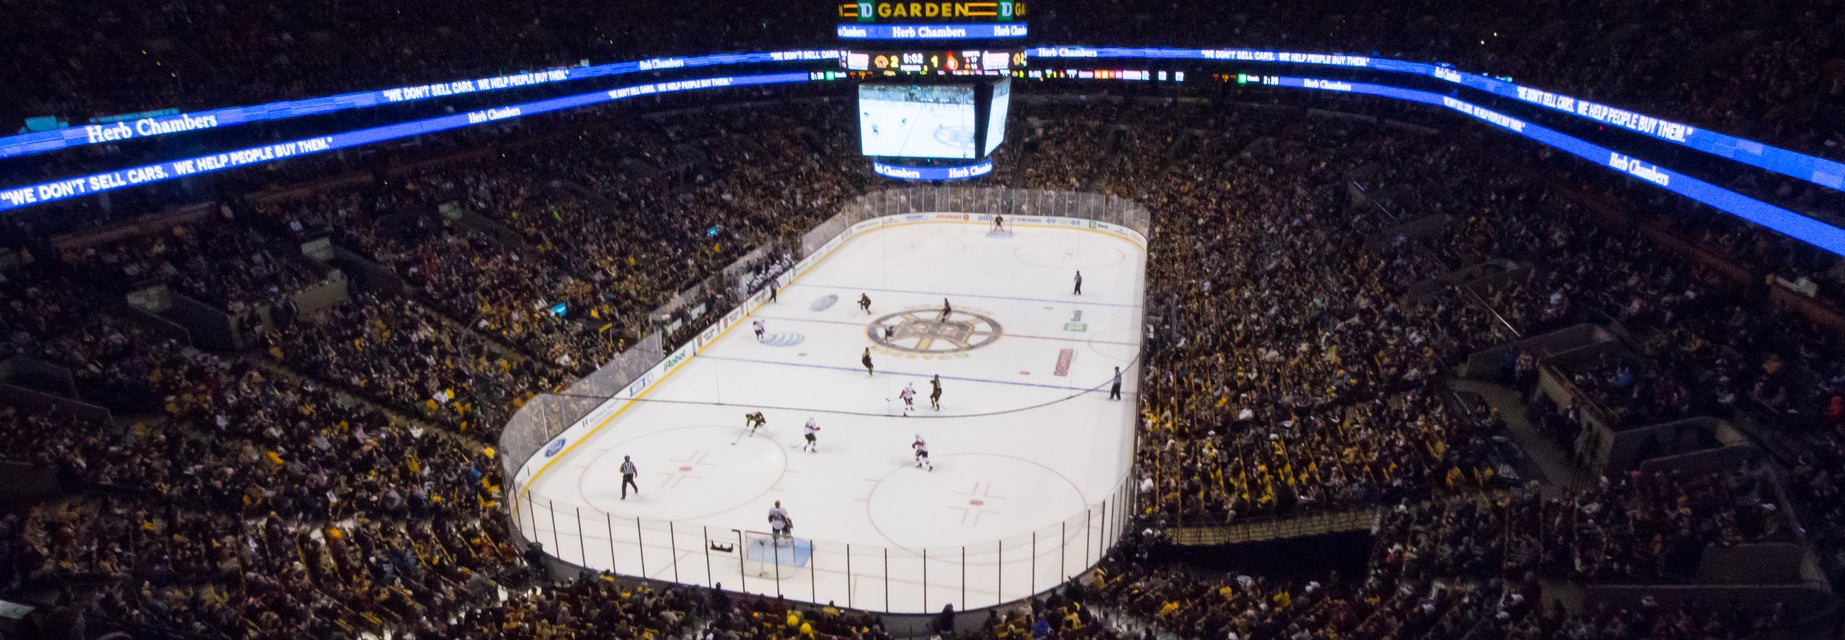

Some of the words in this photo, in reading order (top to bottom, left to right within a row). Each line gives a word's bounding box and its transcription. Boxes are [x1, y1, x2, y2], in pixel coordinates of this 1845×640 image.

[859, 2, 872, 18] TD
[877, 2, 969, 17] GARDEN
[1000, 2, 1012, 17] TD
[892, 26, 916, 38] Herb
[918, 26, 966, 38] Chambers
[994, 25, 1011, 37] Herb
[1038, 48, 1057, 58] Herb
[1059, 48, 1098, 58] Chambers
[1216, 50, 1236, 60] DON'T
[1237, 51, 1254, 60] SELL
[1279, 52, 1290, 61] WE
[1291, 53, 1307, 63] HELP
[1307, 54, 1331, 65] PEOPLE
[1332, 55, 1347, 66] BUY
[890, 55, 899, 68] 2
[930, 55, 938, 68] 1
[403, 85, 430, 100] DON'T
[431, 83, 452, 97] SELL
[452, 80, 475, 95] CARS.
[478, 79, 490, 91] WE
[490, 76, 509, 89] HELP
[509, 73, 535, 86] PEOPLE
[535, 72, 549, 83] BUY
[1304, 78, 1320, 88] Herb
[1320, 79, 1352, 91] Chambers
[468, 111, 487, 124] Herb
[487, 106, 521, 121] Chambers
[1577, 100, 1589, 116] WE
[1589, 103, 1608, 121] HELP
[1607, 106, 1639, 128] PEOPLE
[1638, 114, 1658, 134] BUY
[86, 122, 132, 144] Herb
[136, 113, 218, 136] Chambers
[39, 180, 86, 201] DON'T
[90, 172, 125, 191] SELL
[128, 165, 169, 184] CARS.
[173, 160, 196, 177] WE
[196, 155, 229, 173] HELP
[231, 148, 274, 167] PEOPLE
[274, 142, 297, 157] BUY
[884, 166, 920, 179] Chambers
[949, 167, 969, 178] Herb
[1609, 152, 1629, 171] Herb
[1629, 159, 1670, 186] Chambers
[663, 349, 686, 373] iRobot
